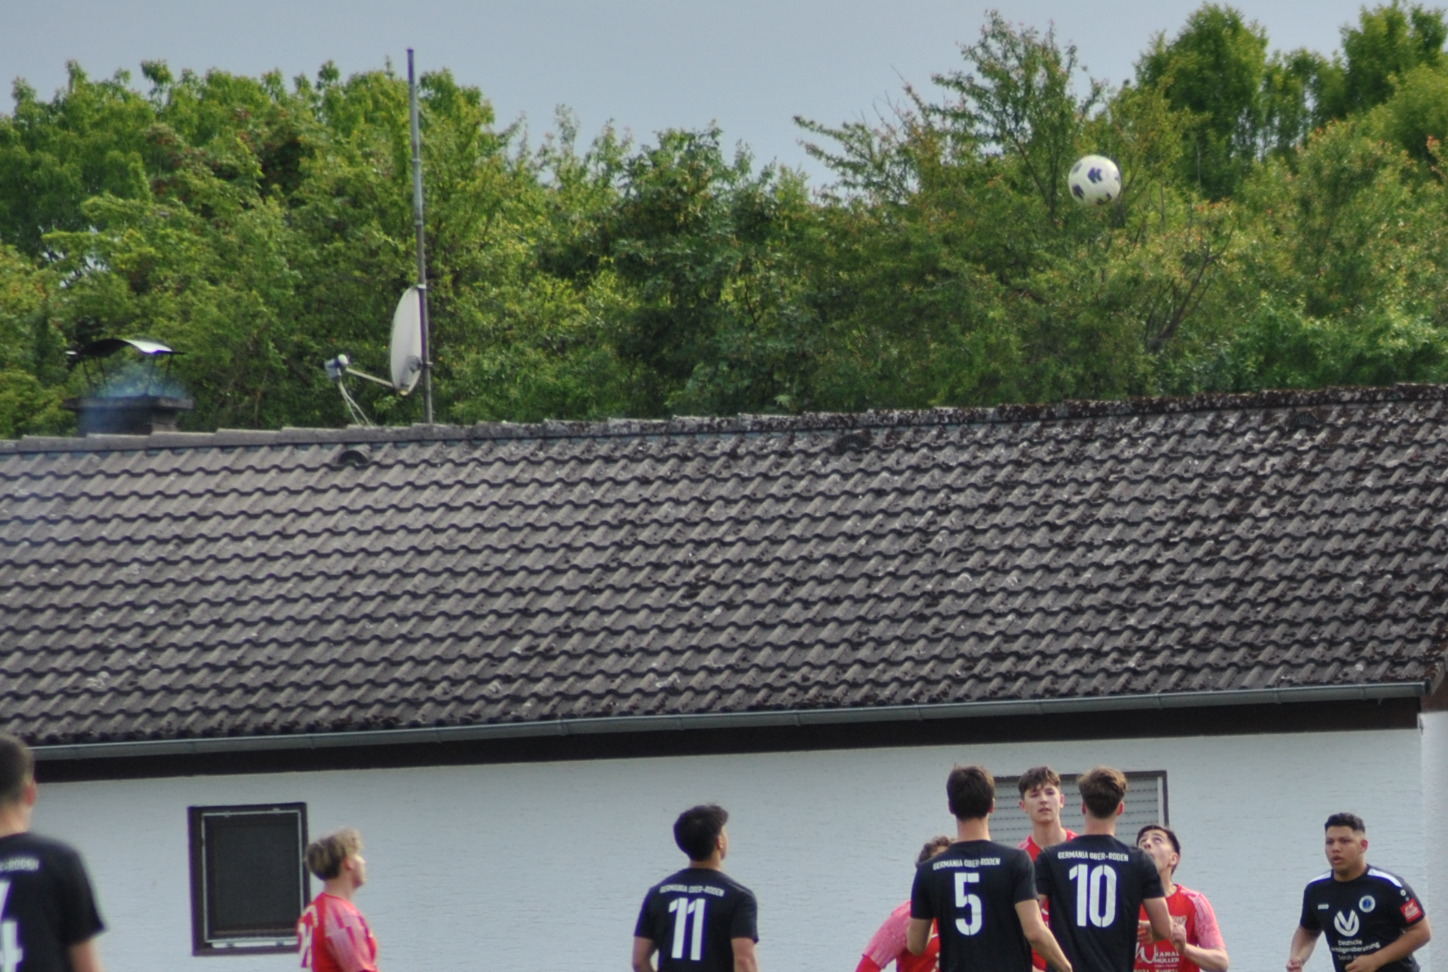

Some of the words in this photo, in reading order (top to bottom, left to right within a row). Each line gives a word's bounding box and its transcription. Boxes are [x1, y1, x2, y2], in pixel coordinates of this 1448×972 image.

[1057, 851, 1089, 860] GERMANIA
[954, 872, 982, 936] 5
[1069, 863, 1117, 928] 10
[669, 897, 706, 961] 11
